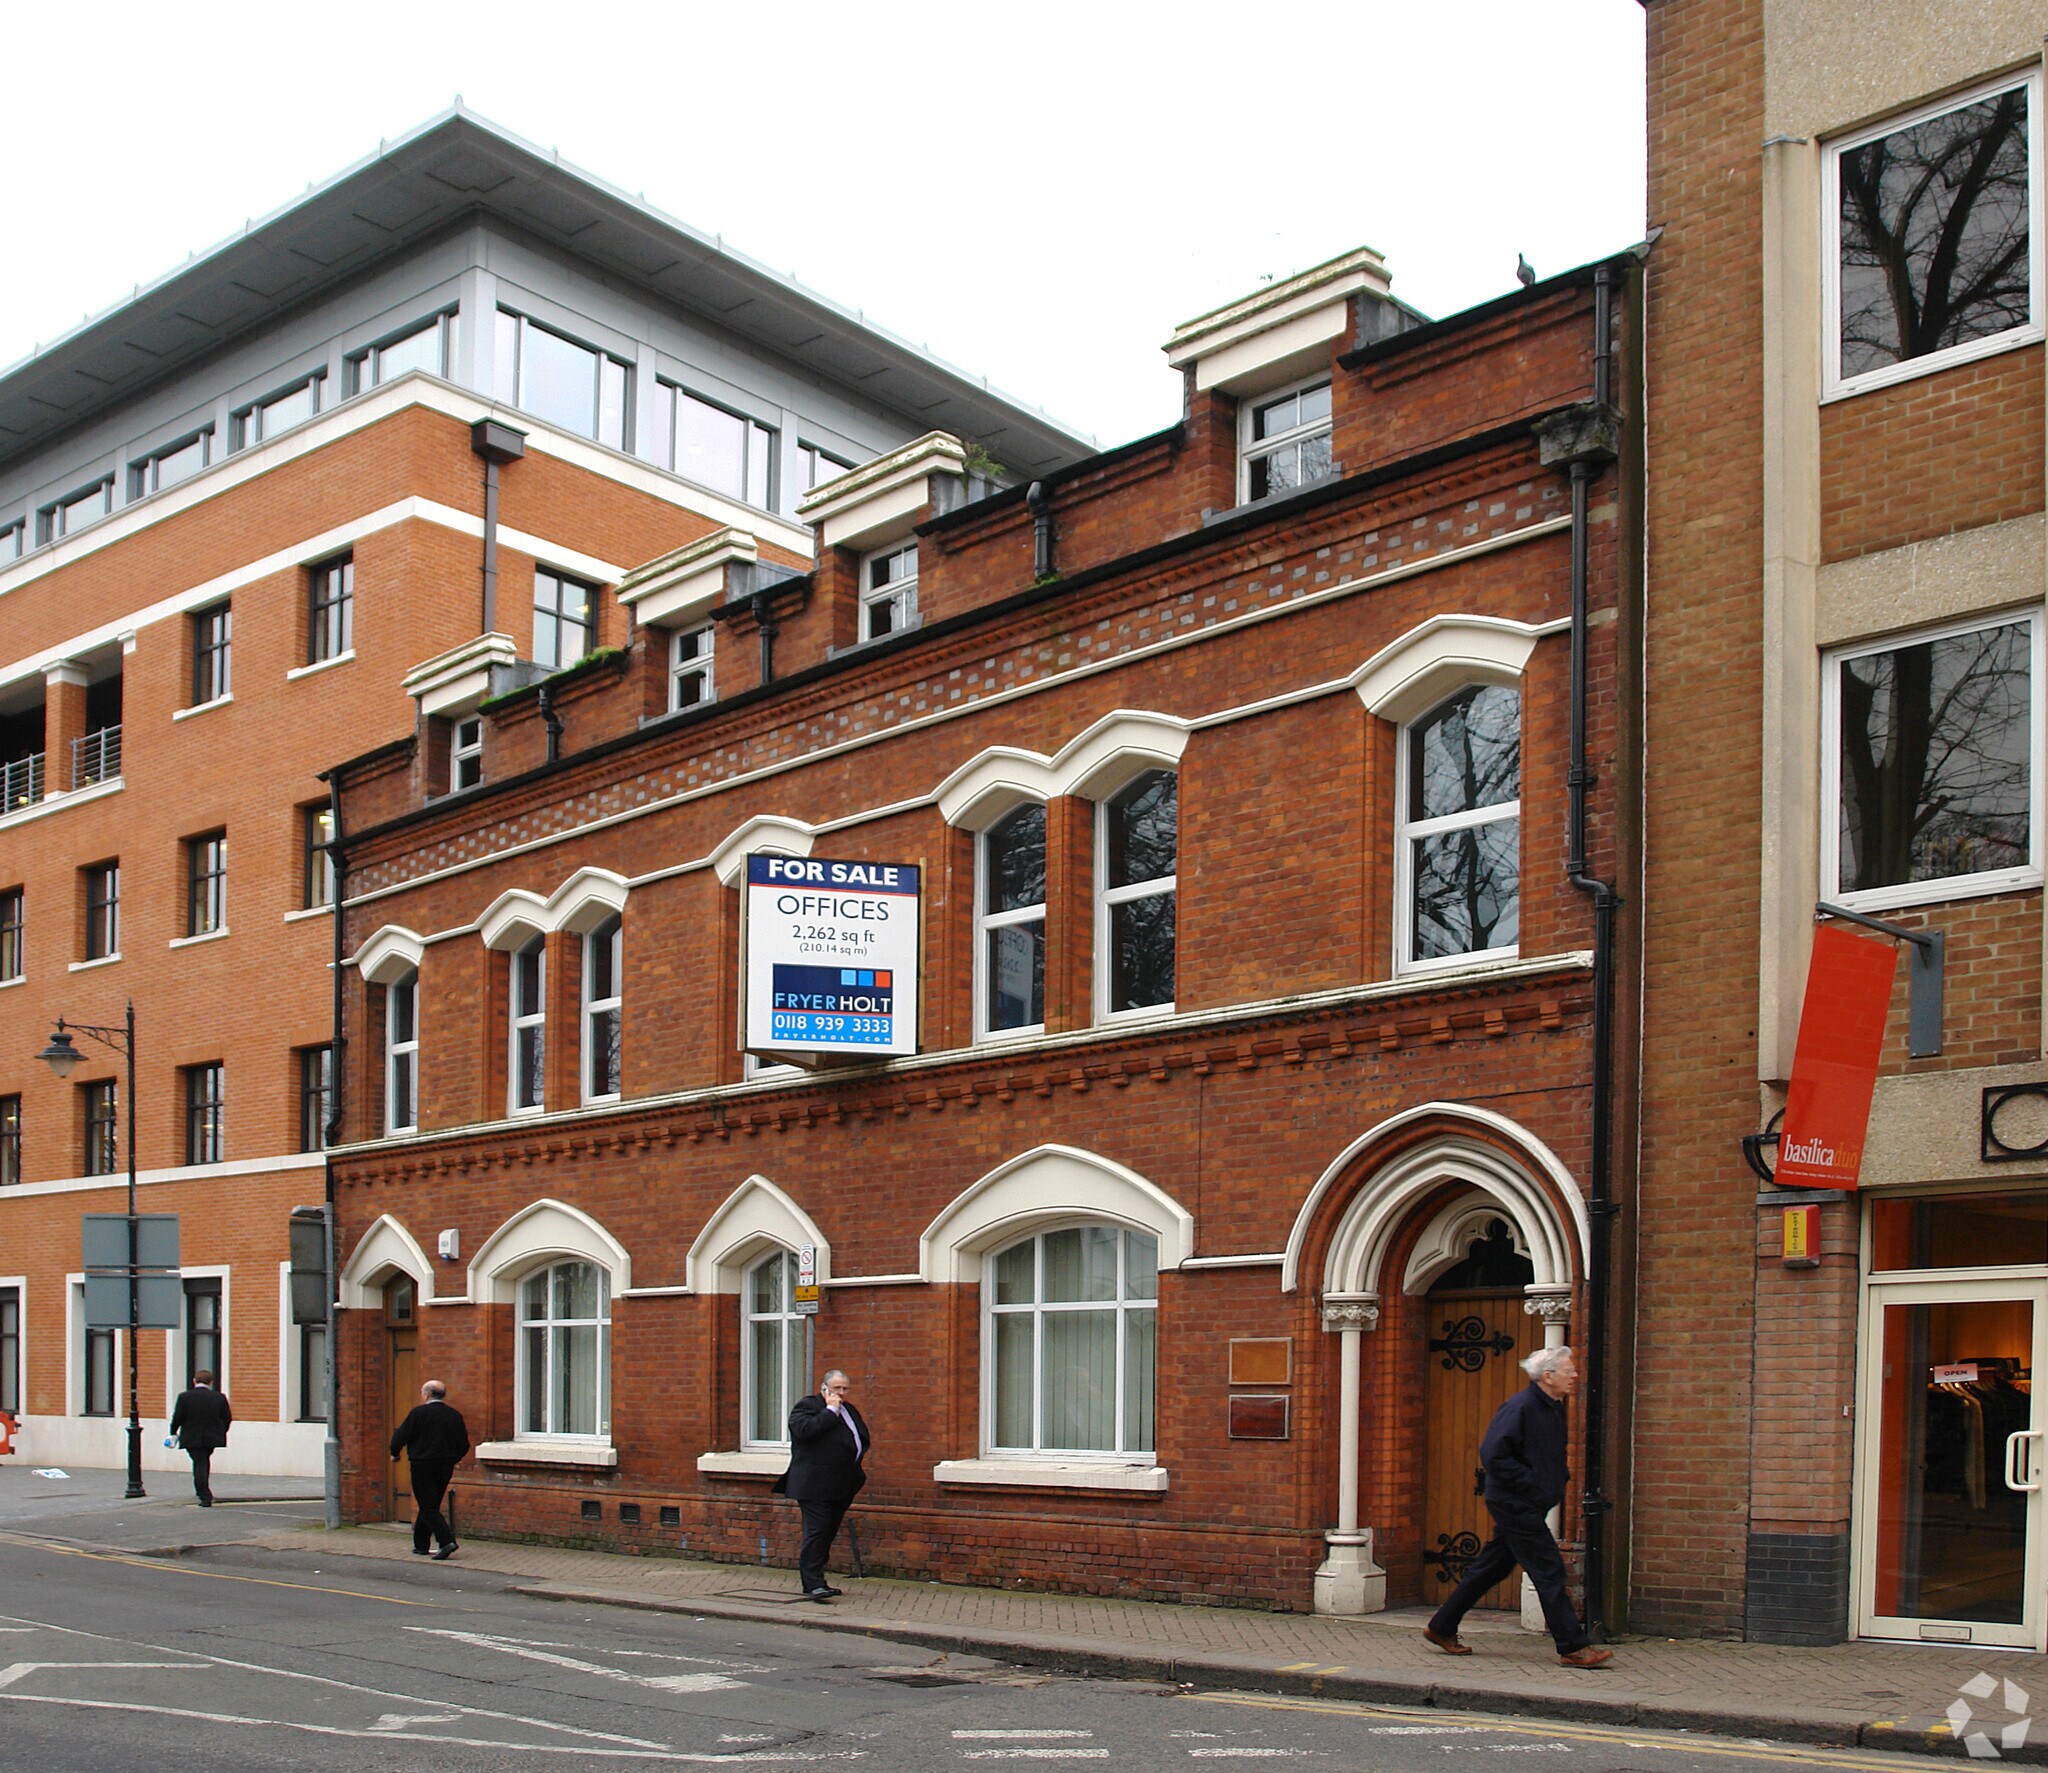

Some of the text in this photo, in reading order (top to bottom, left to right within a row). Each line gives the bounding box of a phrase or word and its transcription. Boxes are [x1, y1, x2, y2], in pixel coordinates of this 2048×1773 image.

[769, 859, 898, 886] FOR SALE
[777, 894, 889, 921] OFFICES
[792, 924, 875, 946] 2,262 sq ft
[799, 942, 868, 957] (210.14 sq m)
[775, 1015, 890, 1033] 0118 939 3333
